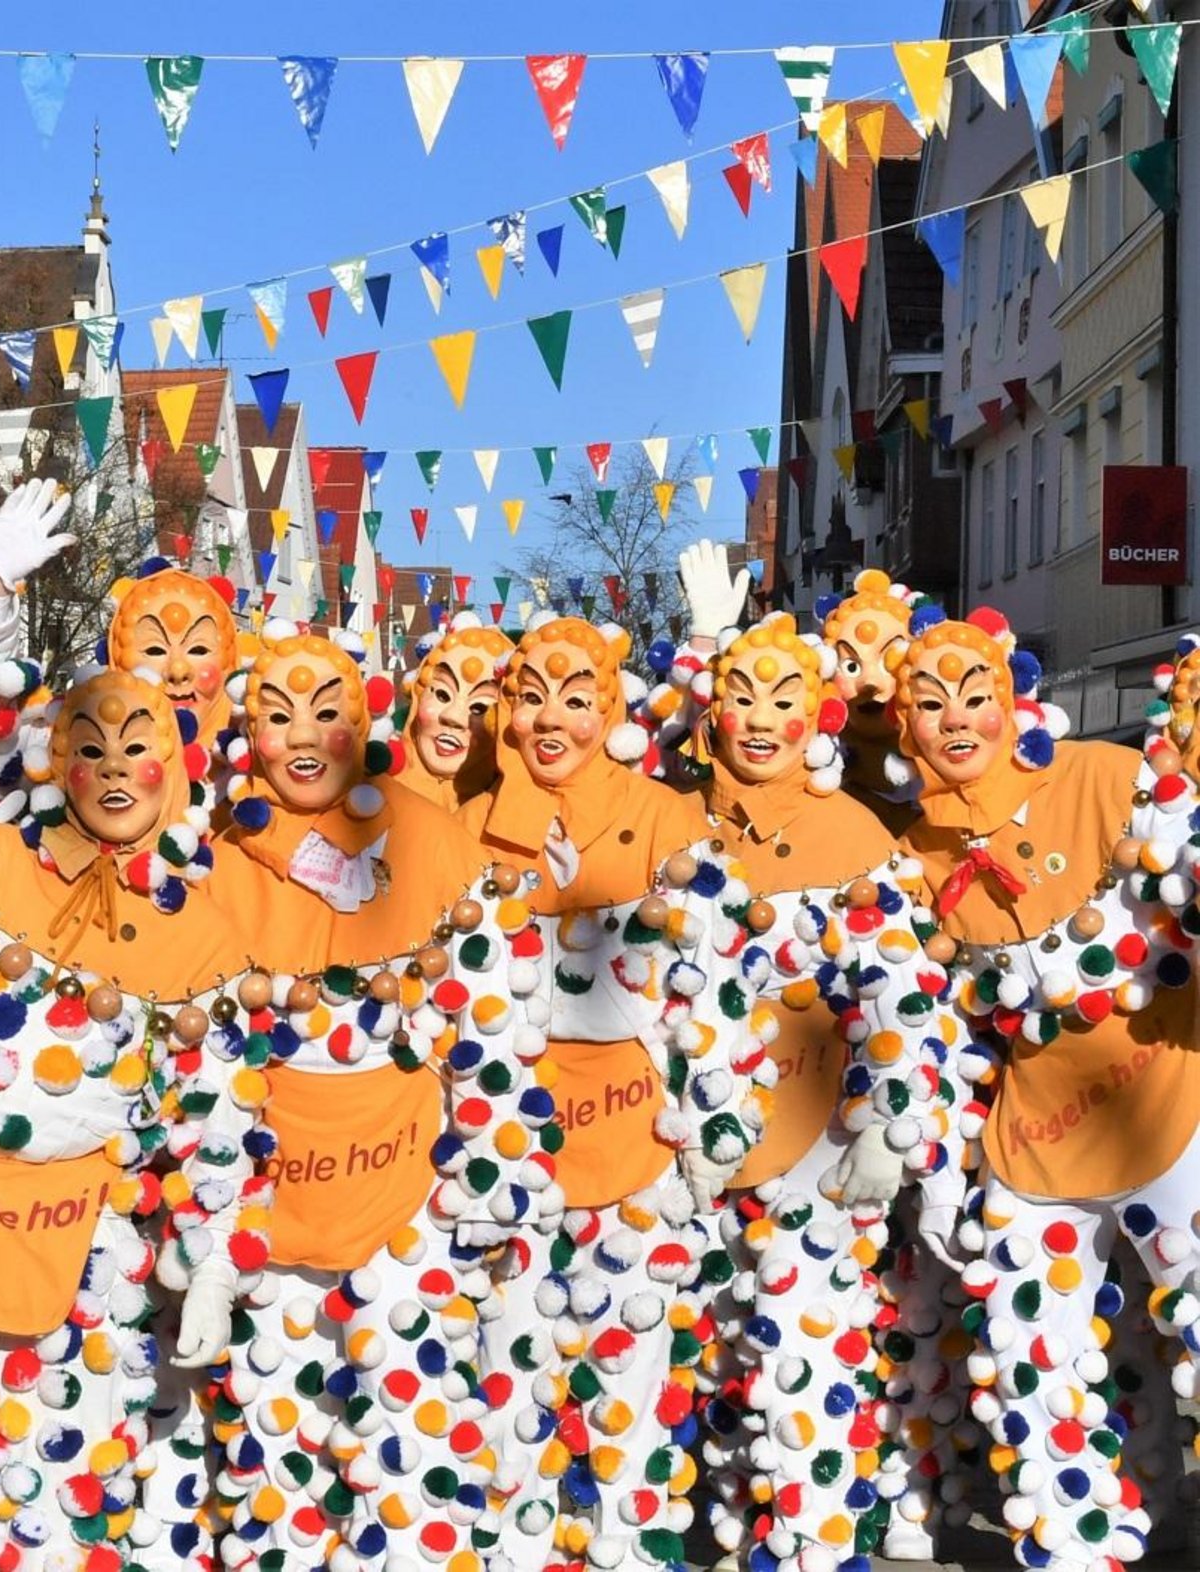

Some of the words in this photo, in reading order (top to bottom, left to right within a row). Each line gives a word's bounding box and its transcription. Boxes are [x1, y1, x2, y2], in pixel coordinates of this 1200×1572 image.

[1108, 545, 1179, 561] BÜCHER
[778, 1047, 806, 1079] oi
[554, 1098, 596, 1131] ele
[604, 1066, 654, 1117] hoi
[1008, 1082, 1108, 1156] Kügele
[265, 1150, 337, 1188] gele
[347, 1130, 403, 1176] hoi
[409, 1122, 417, 1156] !
[27, 1188, 90, 1231] hoi
[96, 1182, 109, 1218] !
